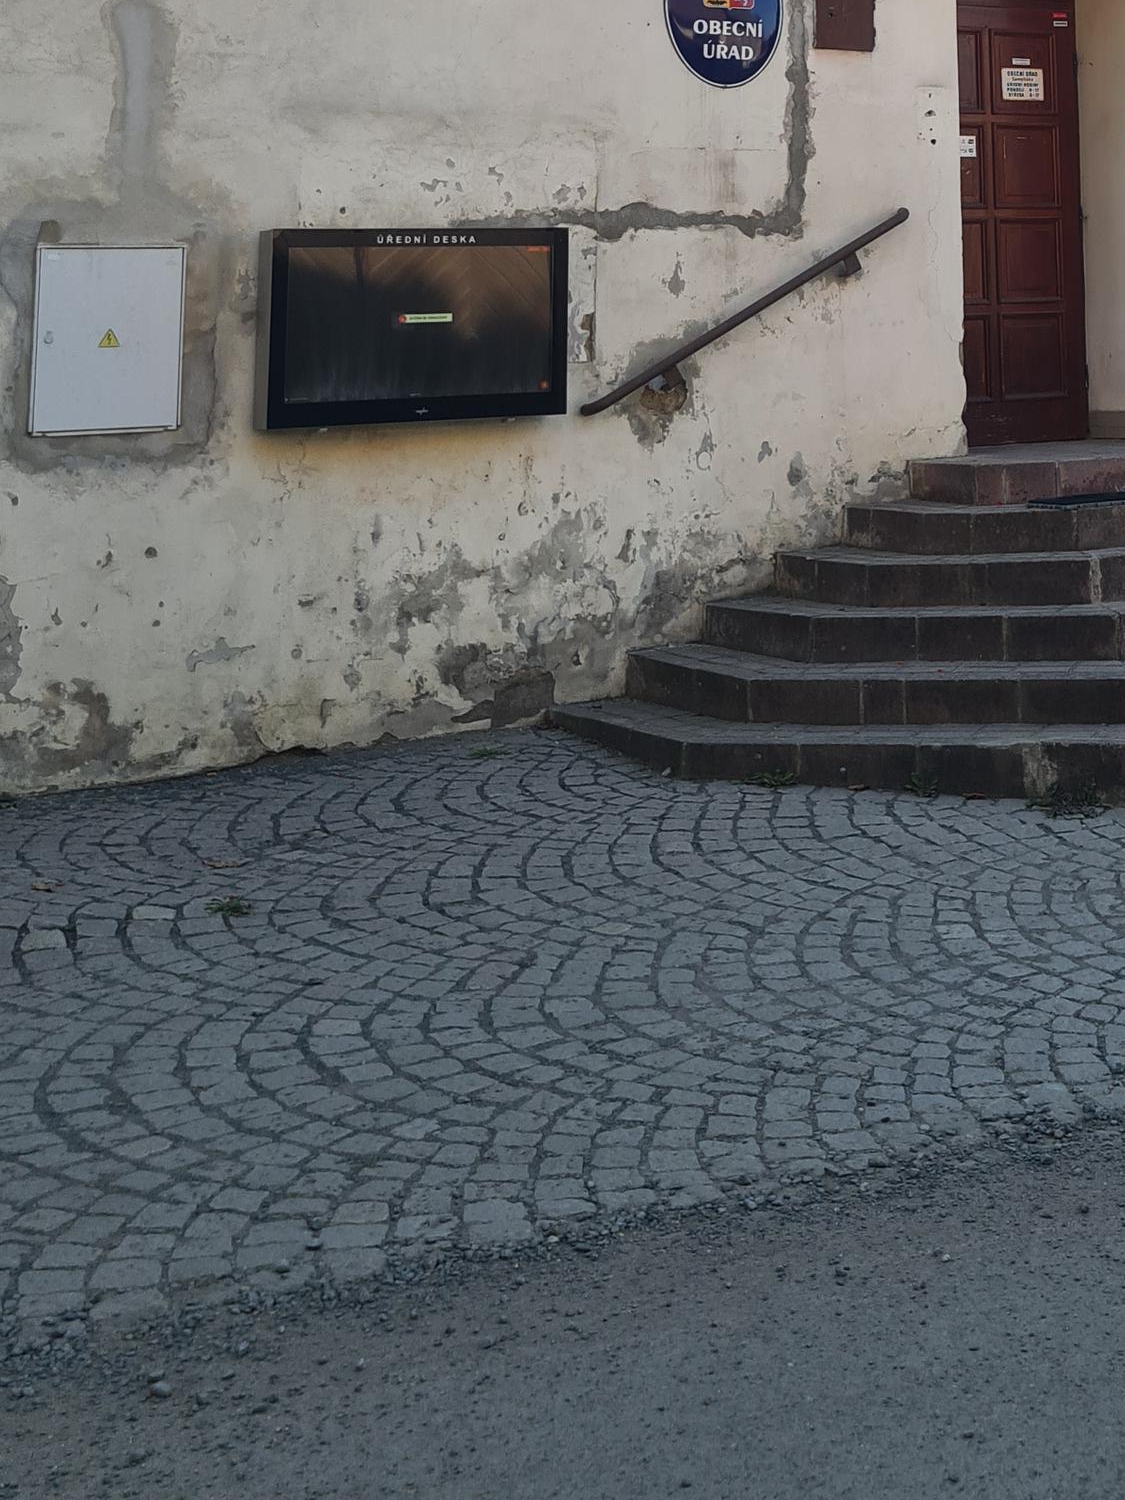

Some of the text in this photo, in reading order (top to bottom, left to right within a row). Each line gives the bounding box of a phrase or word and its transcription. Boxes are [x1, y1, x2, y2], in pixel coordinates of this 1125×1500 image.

[693, 19, 763, 38] OBECNÍ
[702, 39, 754, 61] ÚŘAD
[377, 234, 476, 244] ÚŘEDNÍ DESKA
